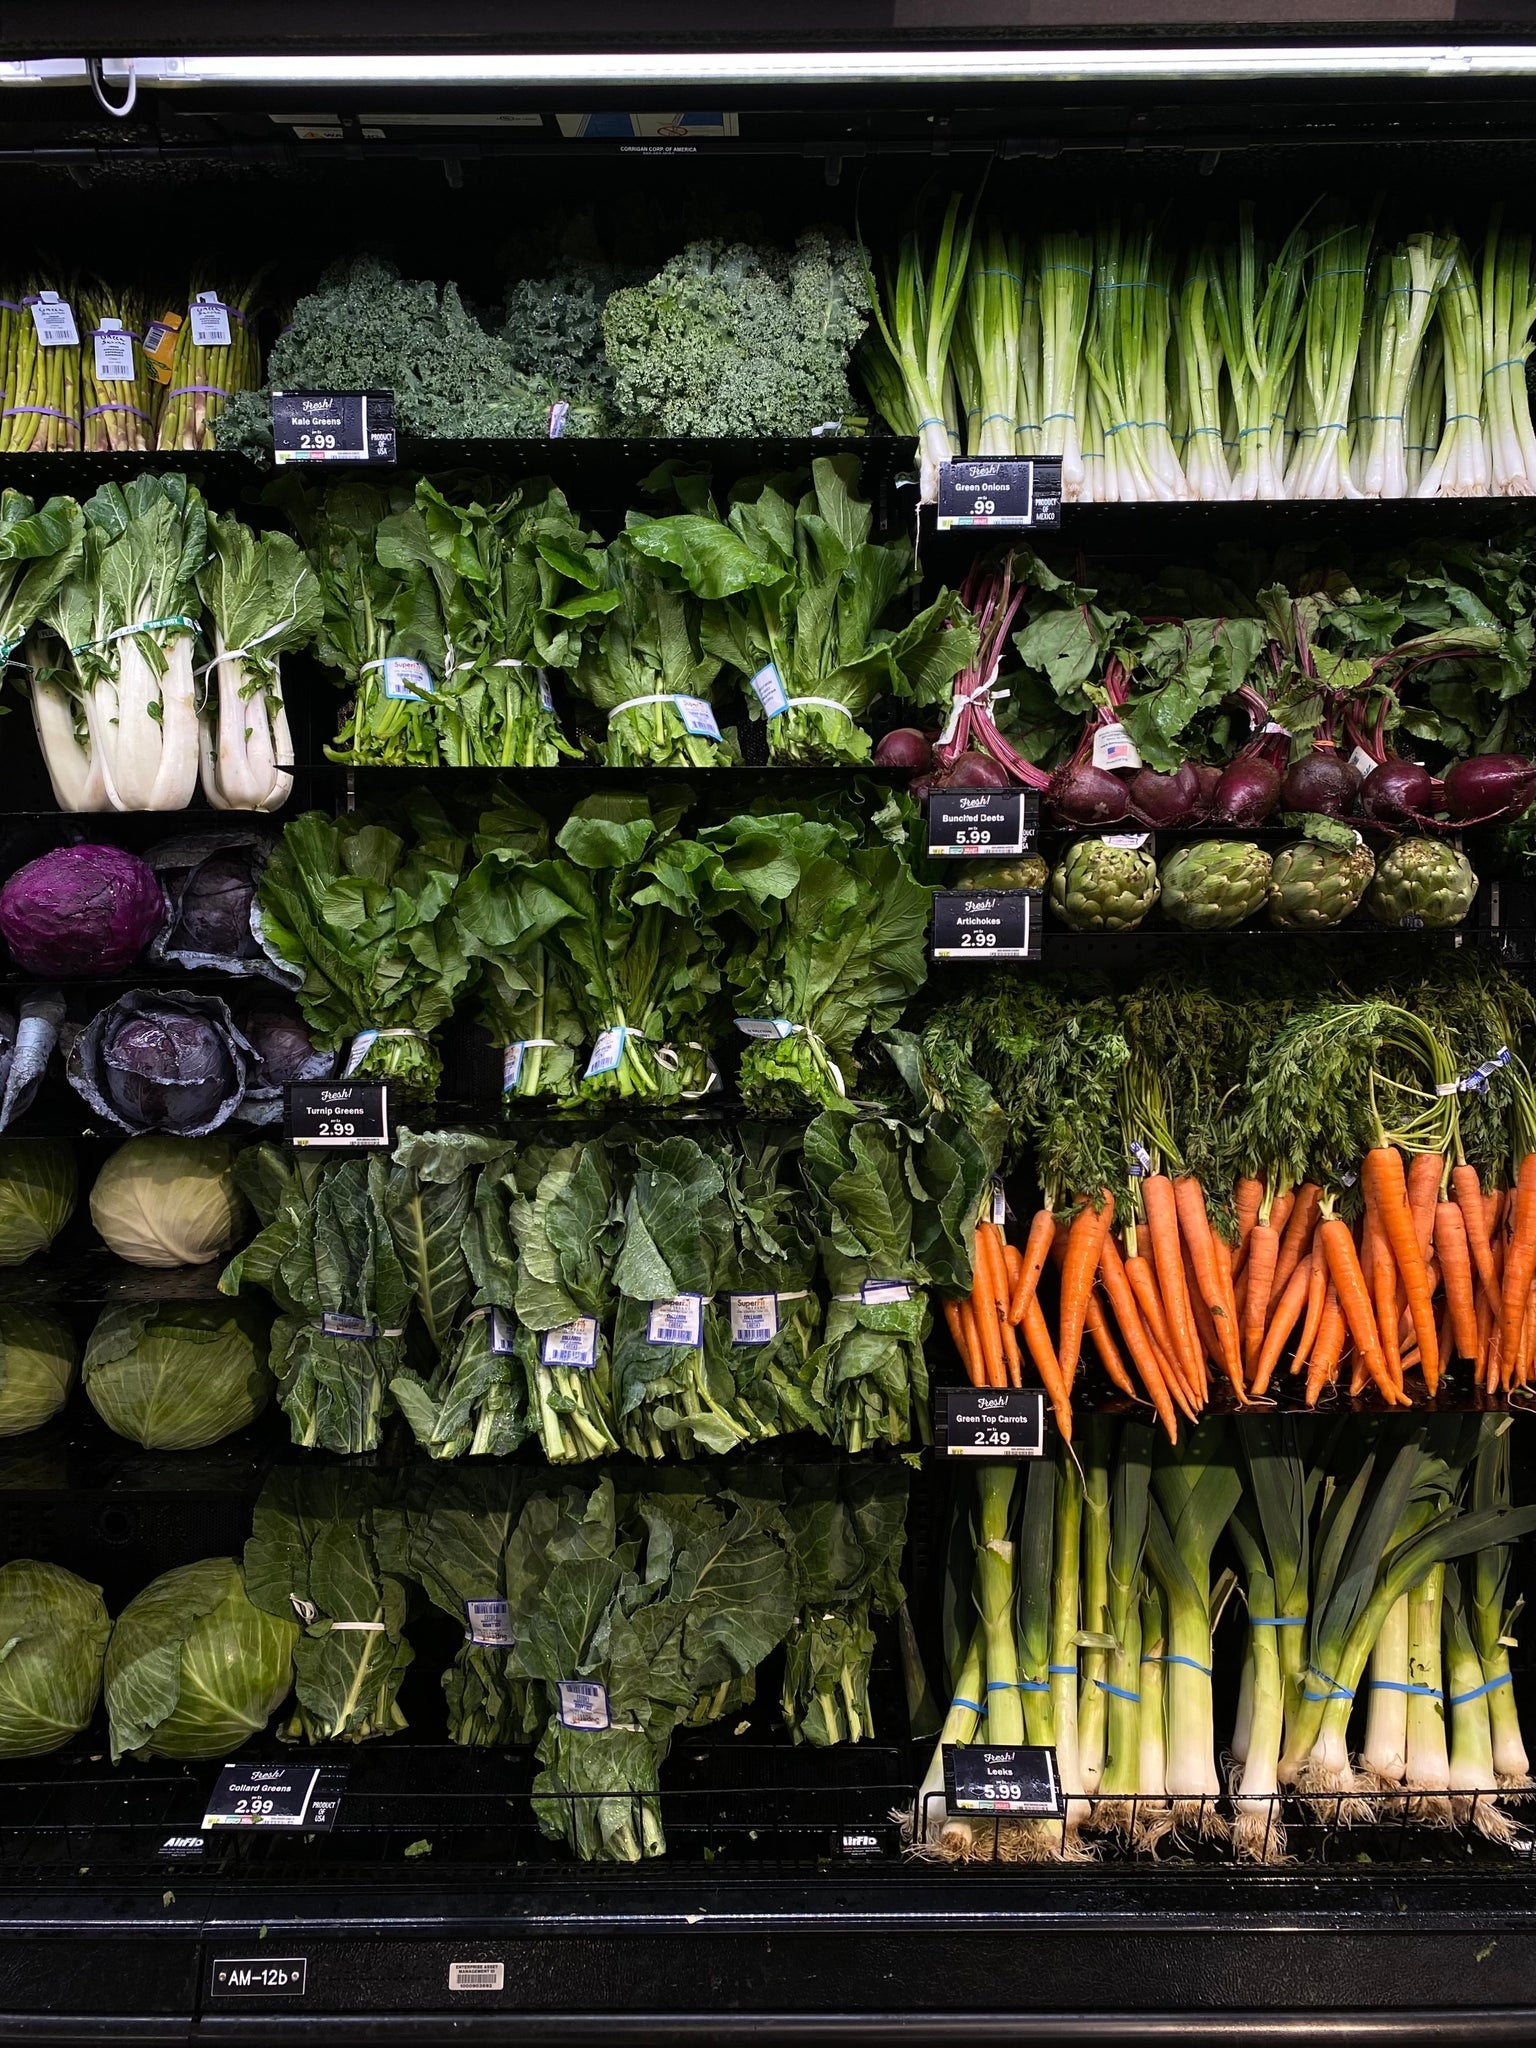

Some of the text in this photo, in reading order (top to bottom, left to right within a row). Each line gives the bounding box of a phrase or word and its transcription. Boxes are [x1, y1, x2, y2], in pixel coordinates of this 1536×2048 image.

[292, 417, 342, 426] Kale Greens
[300, 434, 336, 449] 2.99
[371, 433, 392, 441] PRODUCT
[377, 447, 388, 455] USA
[955, 482, 1010, 491] Green Onions
[969, 500, 996, 515] .99
[1036, 512, 1056, 520] MEXICO
[980, 815, 1005, 823] Beets
[955, 830, 991, 844] 5.99
[1023, 829, 1035, 837] DUCT
[957, 917, 1002, 926] Artichokes
[960, 933, 997, 947] 2.99
[306, 1107, 365, 1116] Turnip Greens
[318, 1123, 355, 1136] 2.99
[956, 1414, 1028, 1424] Green Top Carrots
[974, 1432, 1010, 1445] 2.49
[987, 1767, 1013, 1776] Leeks
[229, 1784, 292, 1793] Collard Greens
[984, 1784, 1021, 1799] 5.99
[234, 1800, 273, 1814] 2.99
[312, 1801, 336, 1809] PRODUCT
[314, 1815, 325, 1823] USA
[163, 1837, 204, 1847] AirFlo
[228, 1969, 288, 1986] AM-12b
